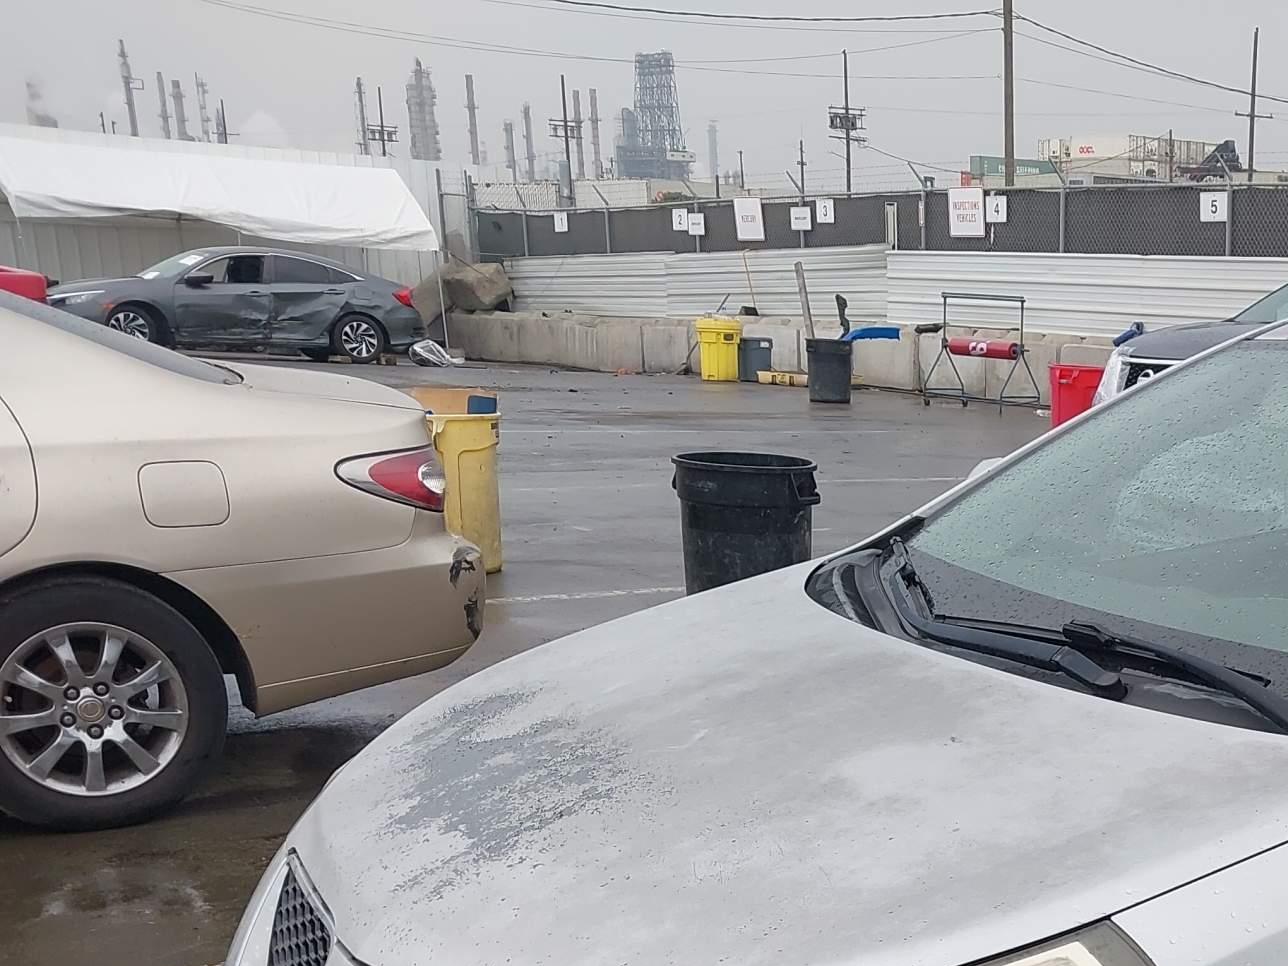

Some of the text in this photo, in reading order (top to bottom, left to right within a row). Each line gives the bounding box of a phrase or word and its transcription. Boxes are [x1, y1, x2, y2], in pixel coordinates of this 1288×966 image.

[822, 205, 828, 217] 3
[993, 202, 1000, 215] 4
[1210, 199, 1218, 214] 5
[677, 214, 683, 225] 2
